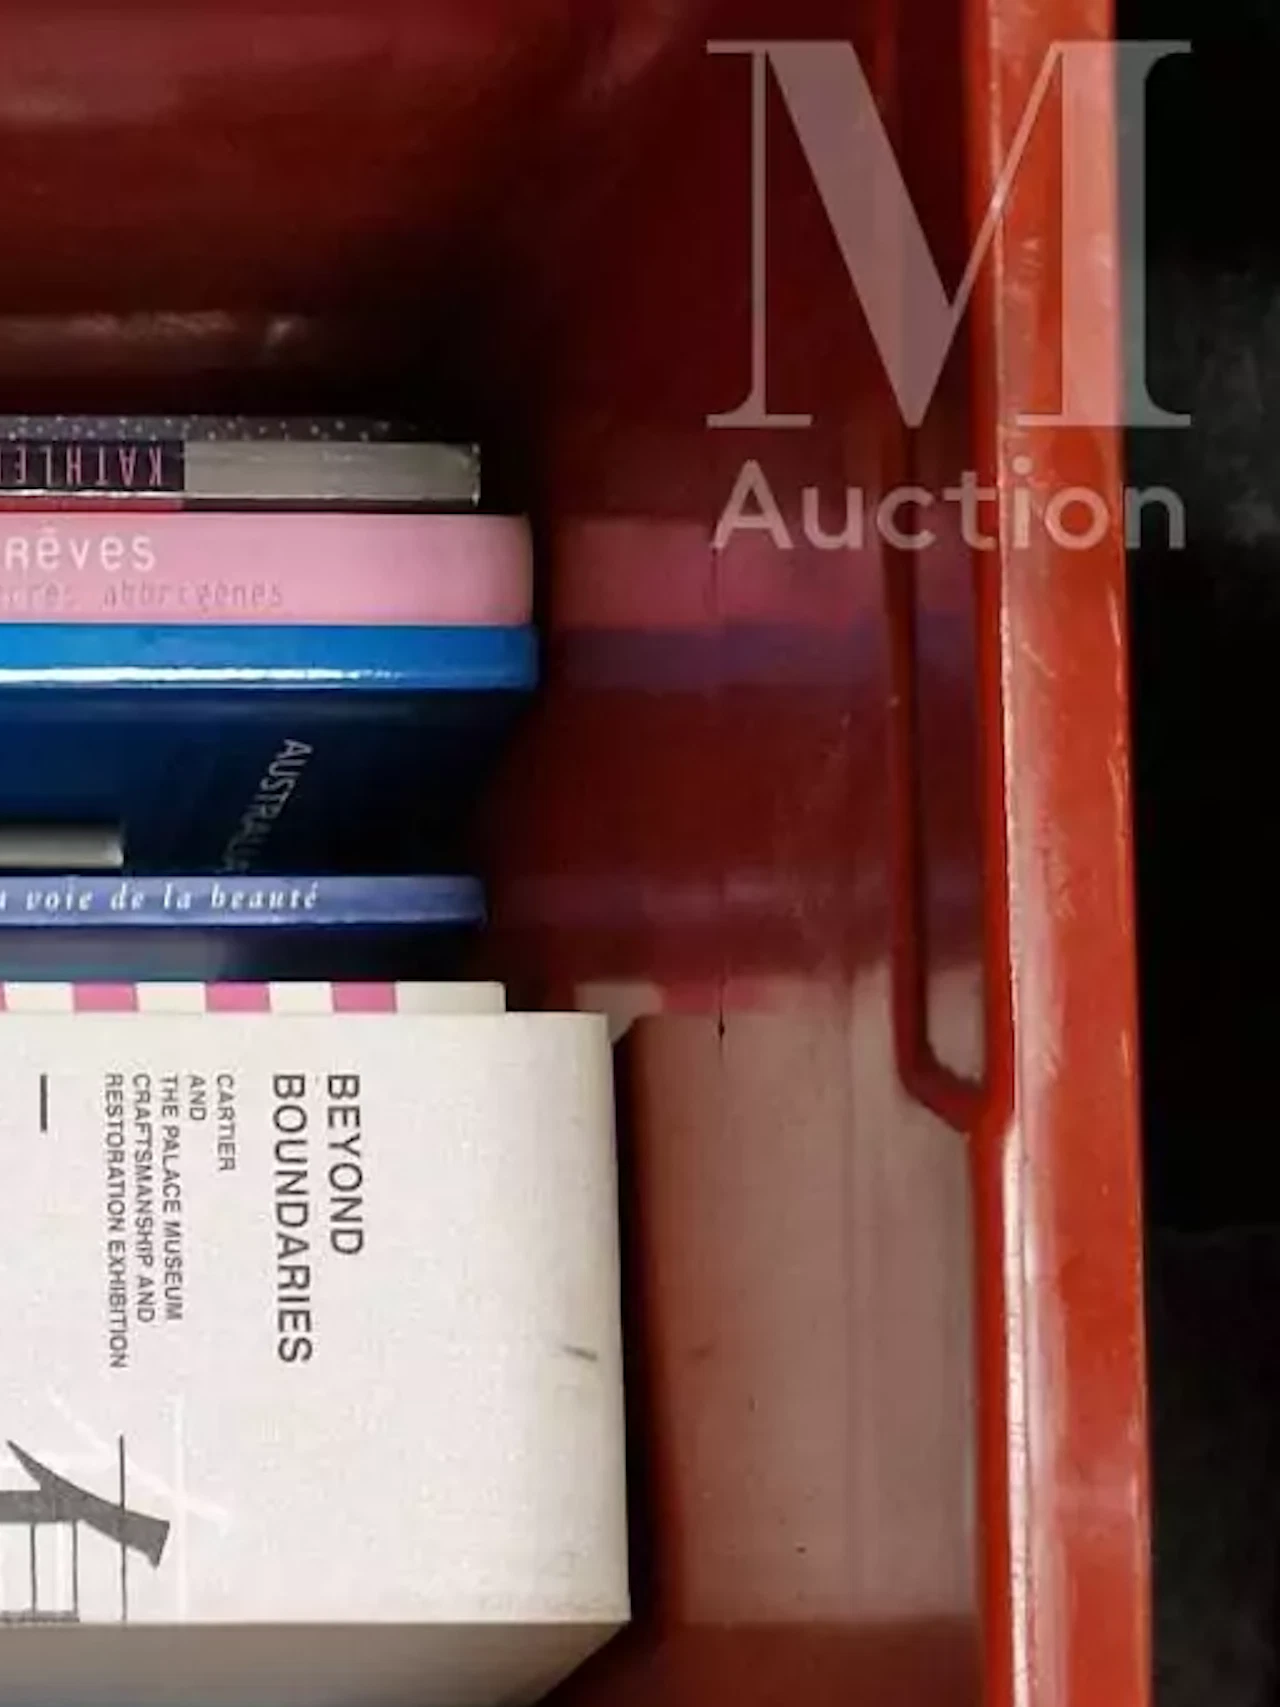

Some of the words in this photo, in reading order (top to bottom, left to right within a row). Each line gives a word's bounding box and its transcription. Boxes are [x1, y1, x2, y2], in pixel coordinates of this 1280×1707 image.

[25, 881, 94, 911] voie
[109, 880, 146, 911] de
[162, 880, 193, 910] la
[209, 880, 320, 910] beauté
[159, 1073, 179, 1118] THE
[189, 1074, 206, 1123] AND
[216, 1074, 236, 1173] CARTIER
[105, 1073, 127, 1232] RESTORATION
[132, 1073, 154, 1268] CRAFTSMANSHIP
[161, 1123, 181, 1213] PALACE
[326, 1074, 365, 1257] BEYOND
[272, 1073, 313, 1365] BOUNDARIES
[108, 1239, 129, 1369] EXHIBITION
[135, 1275, 155, 1323] AND
[163, 1220, 184, 1322] MUSEUM
